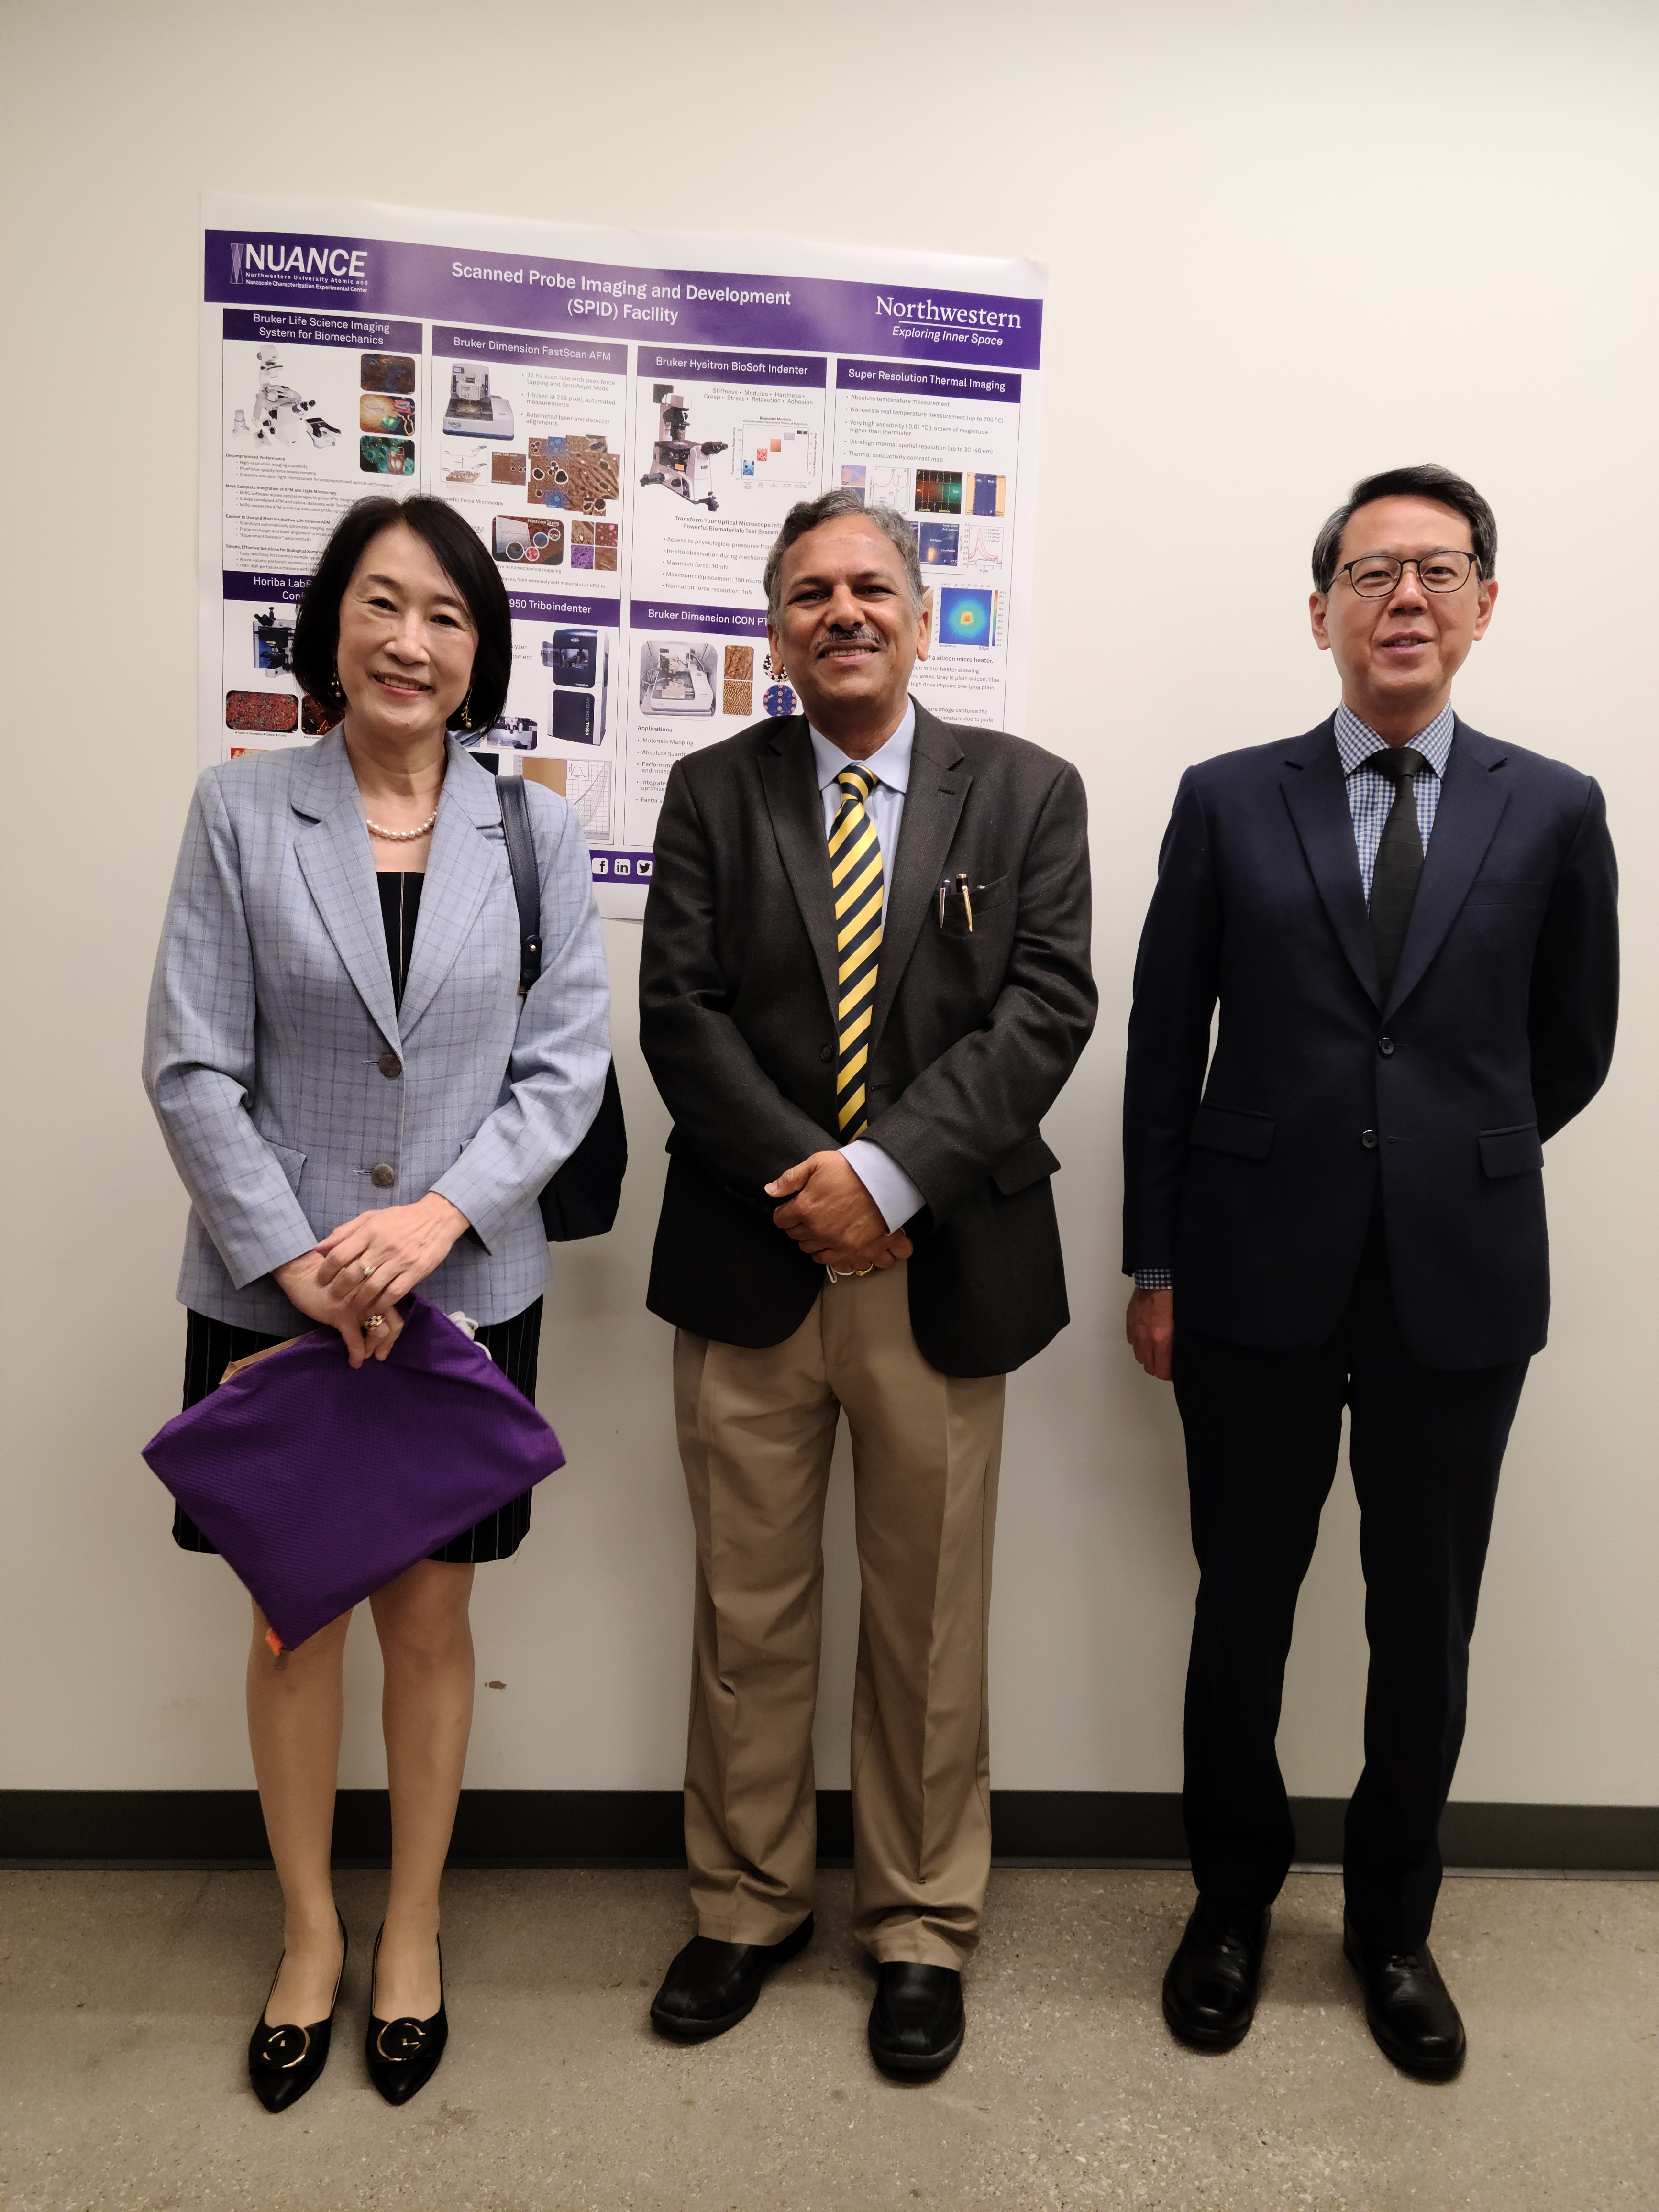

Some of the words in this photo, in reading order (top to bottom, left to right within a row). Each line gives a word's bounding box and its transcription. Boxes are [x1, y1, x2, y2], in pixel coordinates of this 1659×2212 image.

[246, 243, 367, 276] NUANCE
[452, 262, 523, 283] Scanned
[529, 269, 575, 289] Probe
[582, 276, 647, 299] Imaging
[651, 284, 680, 298] and
[686, 285, 791, 305] Development
[568, 298, 618, 320] (SPID)
[623, 304, 678, 325] Facility
[875, 296, 1022, 329] Northwestern
[254, 313, 286, 324] Bruker
[289, 315, 307, 325] Life
[309, 317, 348, 329] Science
[351, 320, 389, 334] Imaging
[259, 327, 295, 338] System
[298, 329, 312, 339] for
[315, 331, 383, 344] Biomechanics
[892, 326, 940, 342] Exploring
[942, 330, 969, 342] Inner
[971, 333, 1003, 346] Space
[453, 336, 486, 348] Bruker
[489, 340, 539, 354] Dimension
[542, 346, 586, 358] FastScan
[589, 351, 610, 361] AFM
[656, 356, 687, 367] Bruker
[690, 359, 729, 370] Hysitron
[731, 361, 766, 372] BioSoft
[769, 364, 808, 375] Indenter
[527, 379, 549, 387] tapping
[562, 382, 591, 390] ScanAsyst
[848, 368, 876, 380] Super
[878, 370, 927, 383] Resolution
[929, 375, 967, 387] Thermal
[969, 378, 1005, 392] Imaging
[695, 539, 730, 547] physiological
[254, 576, 286, 586] Horiba
[694, 574, 733, 582] displacement:
[509, 599, 526, 608] 950
[528, 600, 591, 613] Triboindenter
[648, 609, 679, 619] Bruker
[681, 611, 729, 623] Dimension
[732, 615, 754, 625] ICON
